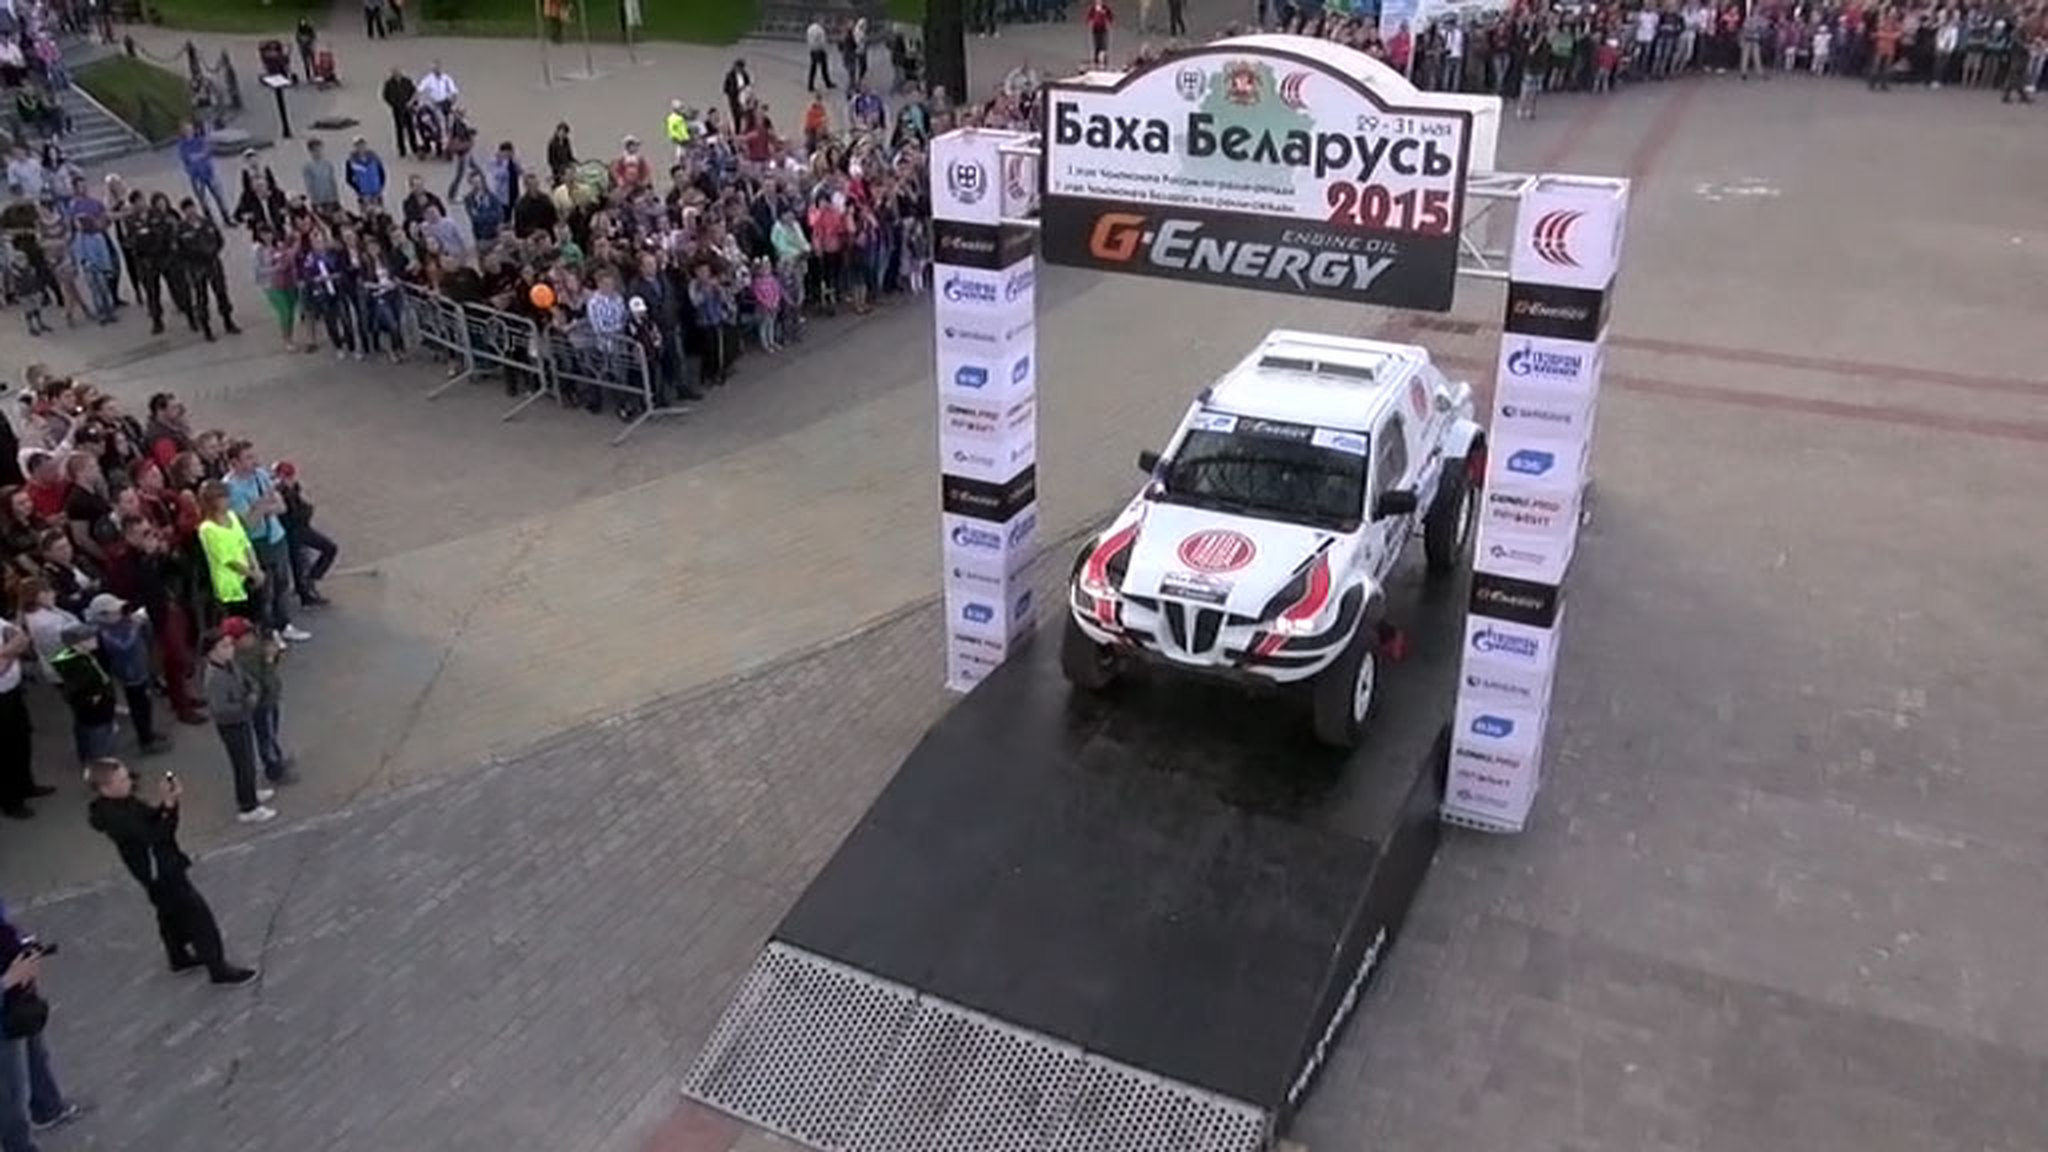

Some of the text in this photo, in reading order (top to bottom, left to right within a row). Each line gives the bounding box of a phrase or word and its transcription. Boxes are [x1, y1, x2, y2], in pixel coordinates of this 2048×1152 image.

[1055, 102, 1453, 183] Баха Беларусь
[1356, 114, 1379, 132] 29
[1394, 117, 1414, 134] 31
[1420, 122, 1452, 136] мая
[1326, 182, 1451, 236] 2015
[1281, 228, 1400, 255] ENGINE OIL
